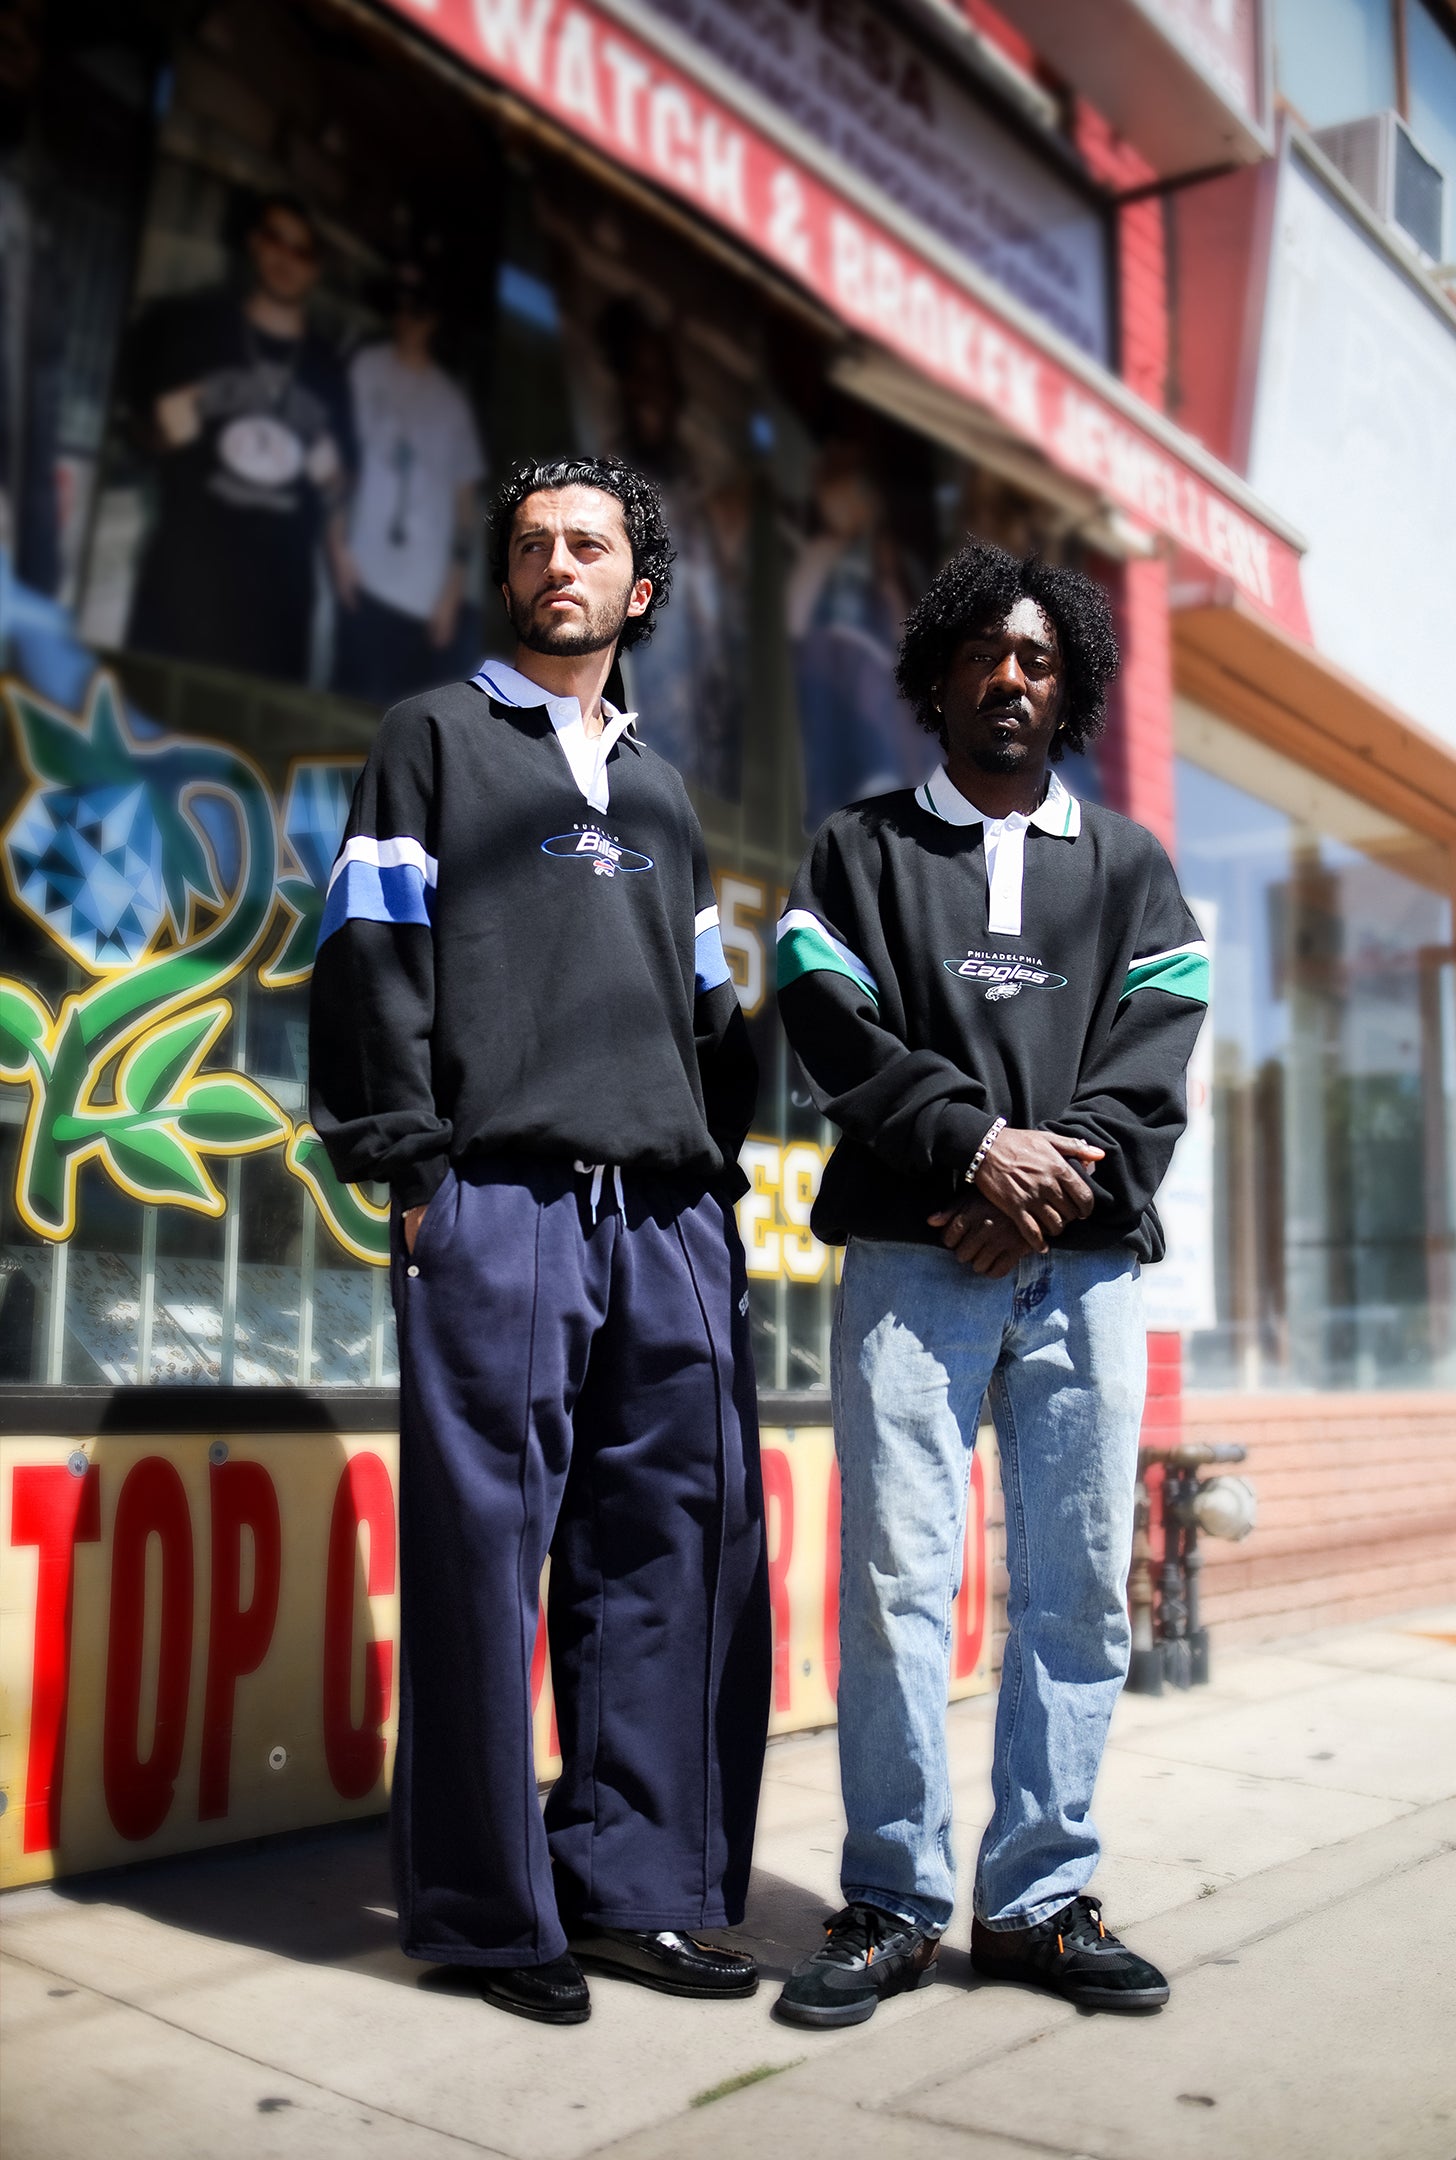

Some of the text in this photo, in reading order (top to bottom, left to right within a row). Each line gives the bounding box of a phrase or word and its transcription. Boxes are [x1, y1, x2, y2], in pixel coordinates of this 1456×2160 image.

[473, 0, 748, 230] WATCH
[767, 166, 812, 275] &
[958, 959, 1049, 984] Eagles
[967, 950, 1043, 966] PHILADELPHIA
[11, 1456, 281, 1854] TOP
